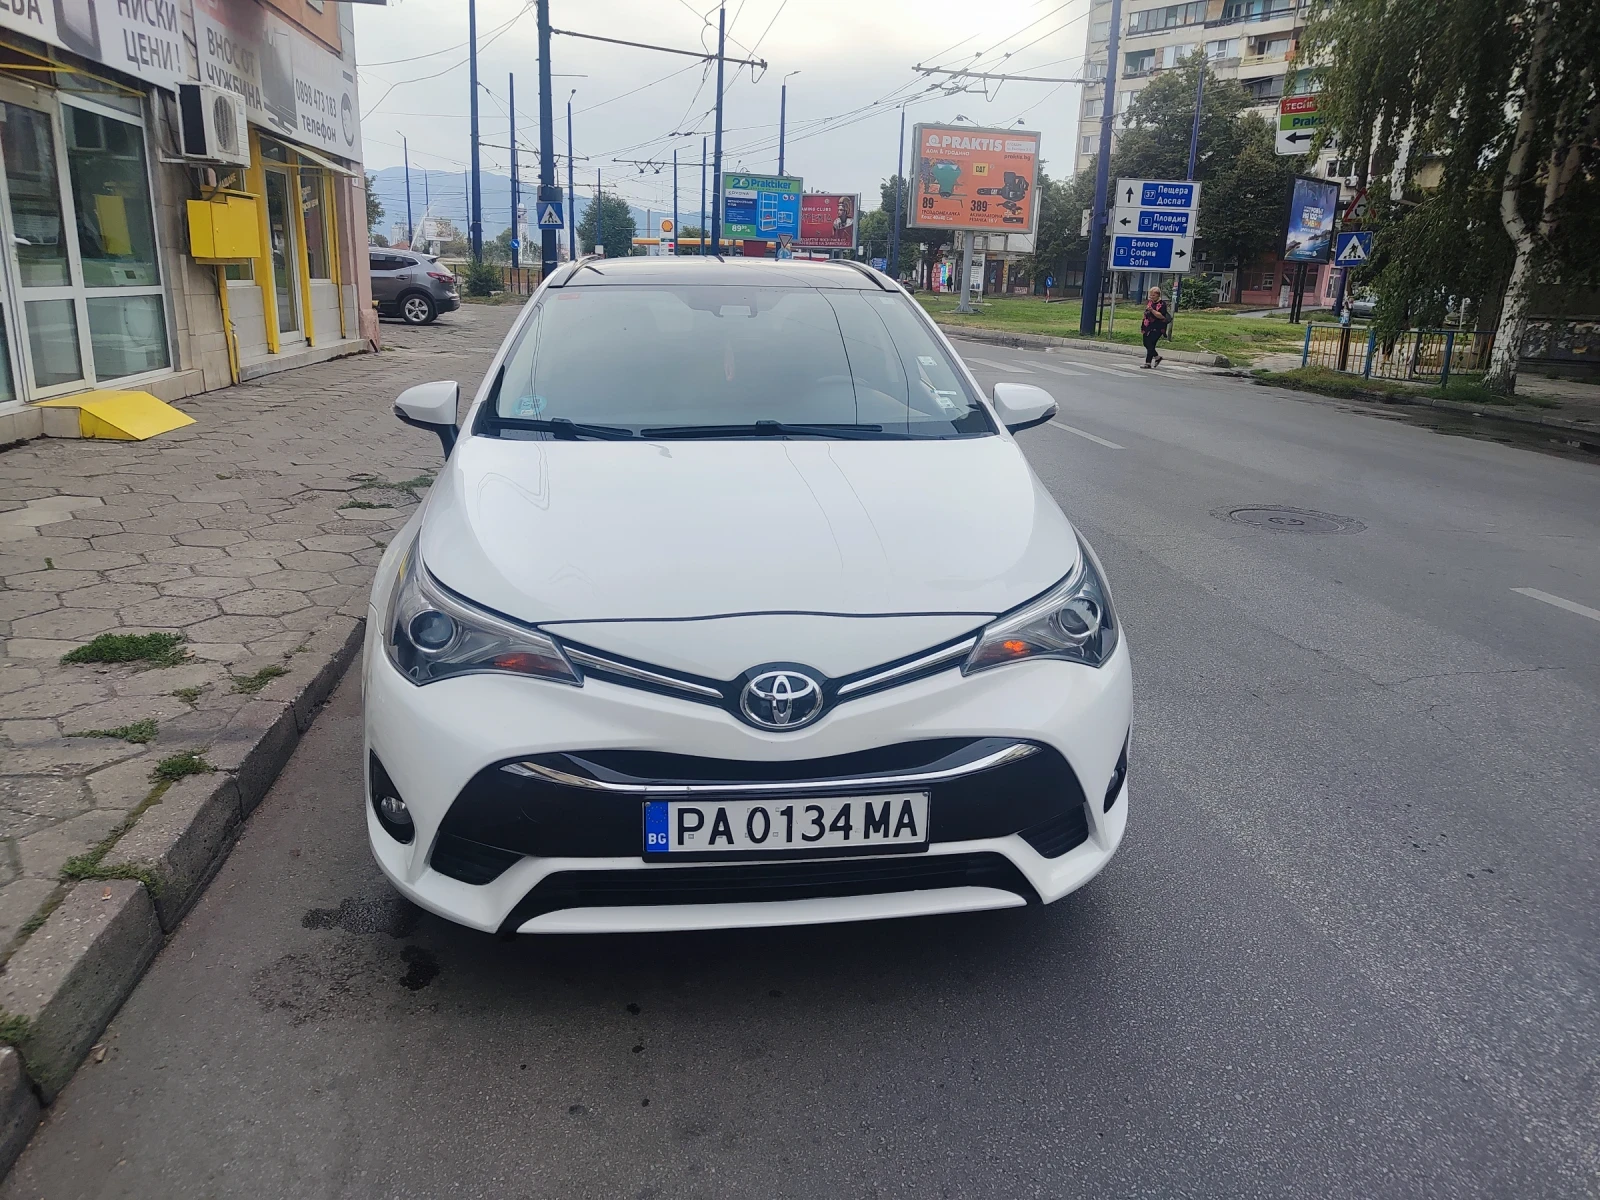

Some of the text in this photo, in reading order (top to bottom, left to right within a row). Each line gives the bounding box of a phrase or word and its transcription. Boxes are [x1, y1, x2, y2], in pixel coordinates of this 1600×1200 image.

[206, 26, 240, 70] ВНОС
[240, 47, 255, 78] ОТ
[206, 62, 263, 112] ЧУЖБИНА
[295, 78, 337, 119] 0898 473 183
[301, 113, 337, 145] телефон
[942, 135, 1003, 152] PRAKTIS
[751, 178, 792, 190] Praktiker
[1157, 185, 1188, 195] Пещера
[922, 197, 934, 209] 89
[970, 200, 987, 212] 389
[1156, 197, 1186, 205] Доспат
[1153, 213, 1187, 223] Пловдив
[731, 224, 742, 232] 89
[1152, 223, 1180, 231] Plovdiv
[1131, 239, 1159, 248] Белово
[1130, 249, 1157, 257] София
[1129, 258, 1149, 266] Sofia
[677, 799, 918, 846] PA 0134 MA
[648, 833, 667, 844] BG
